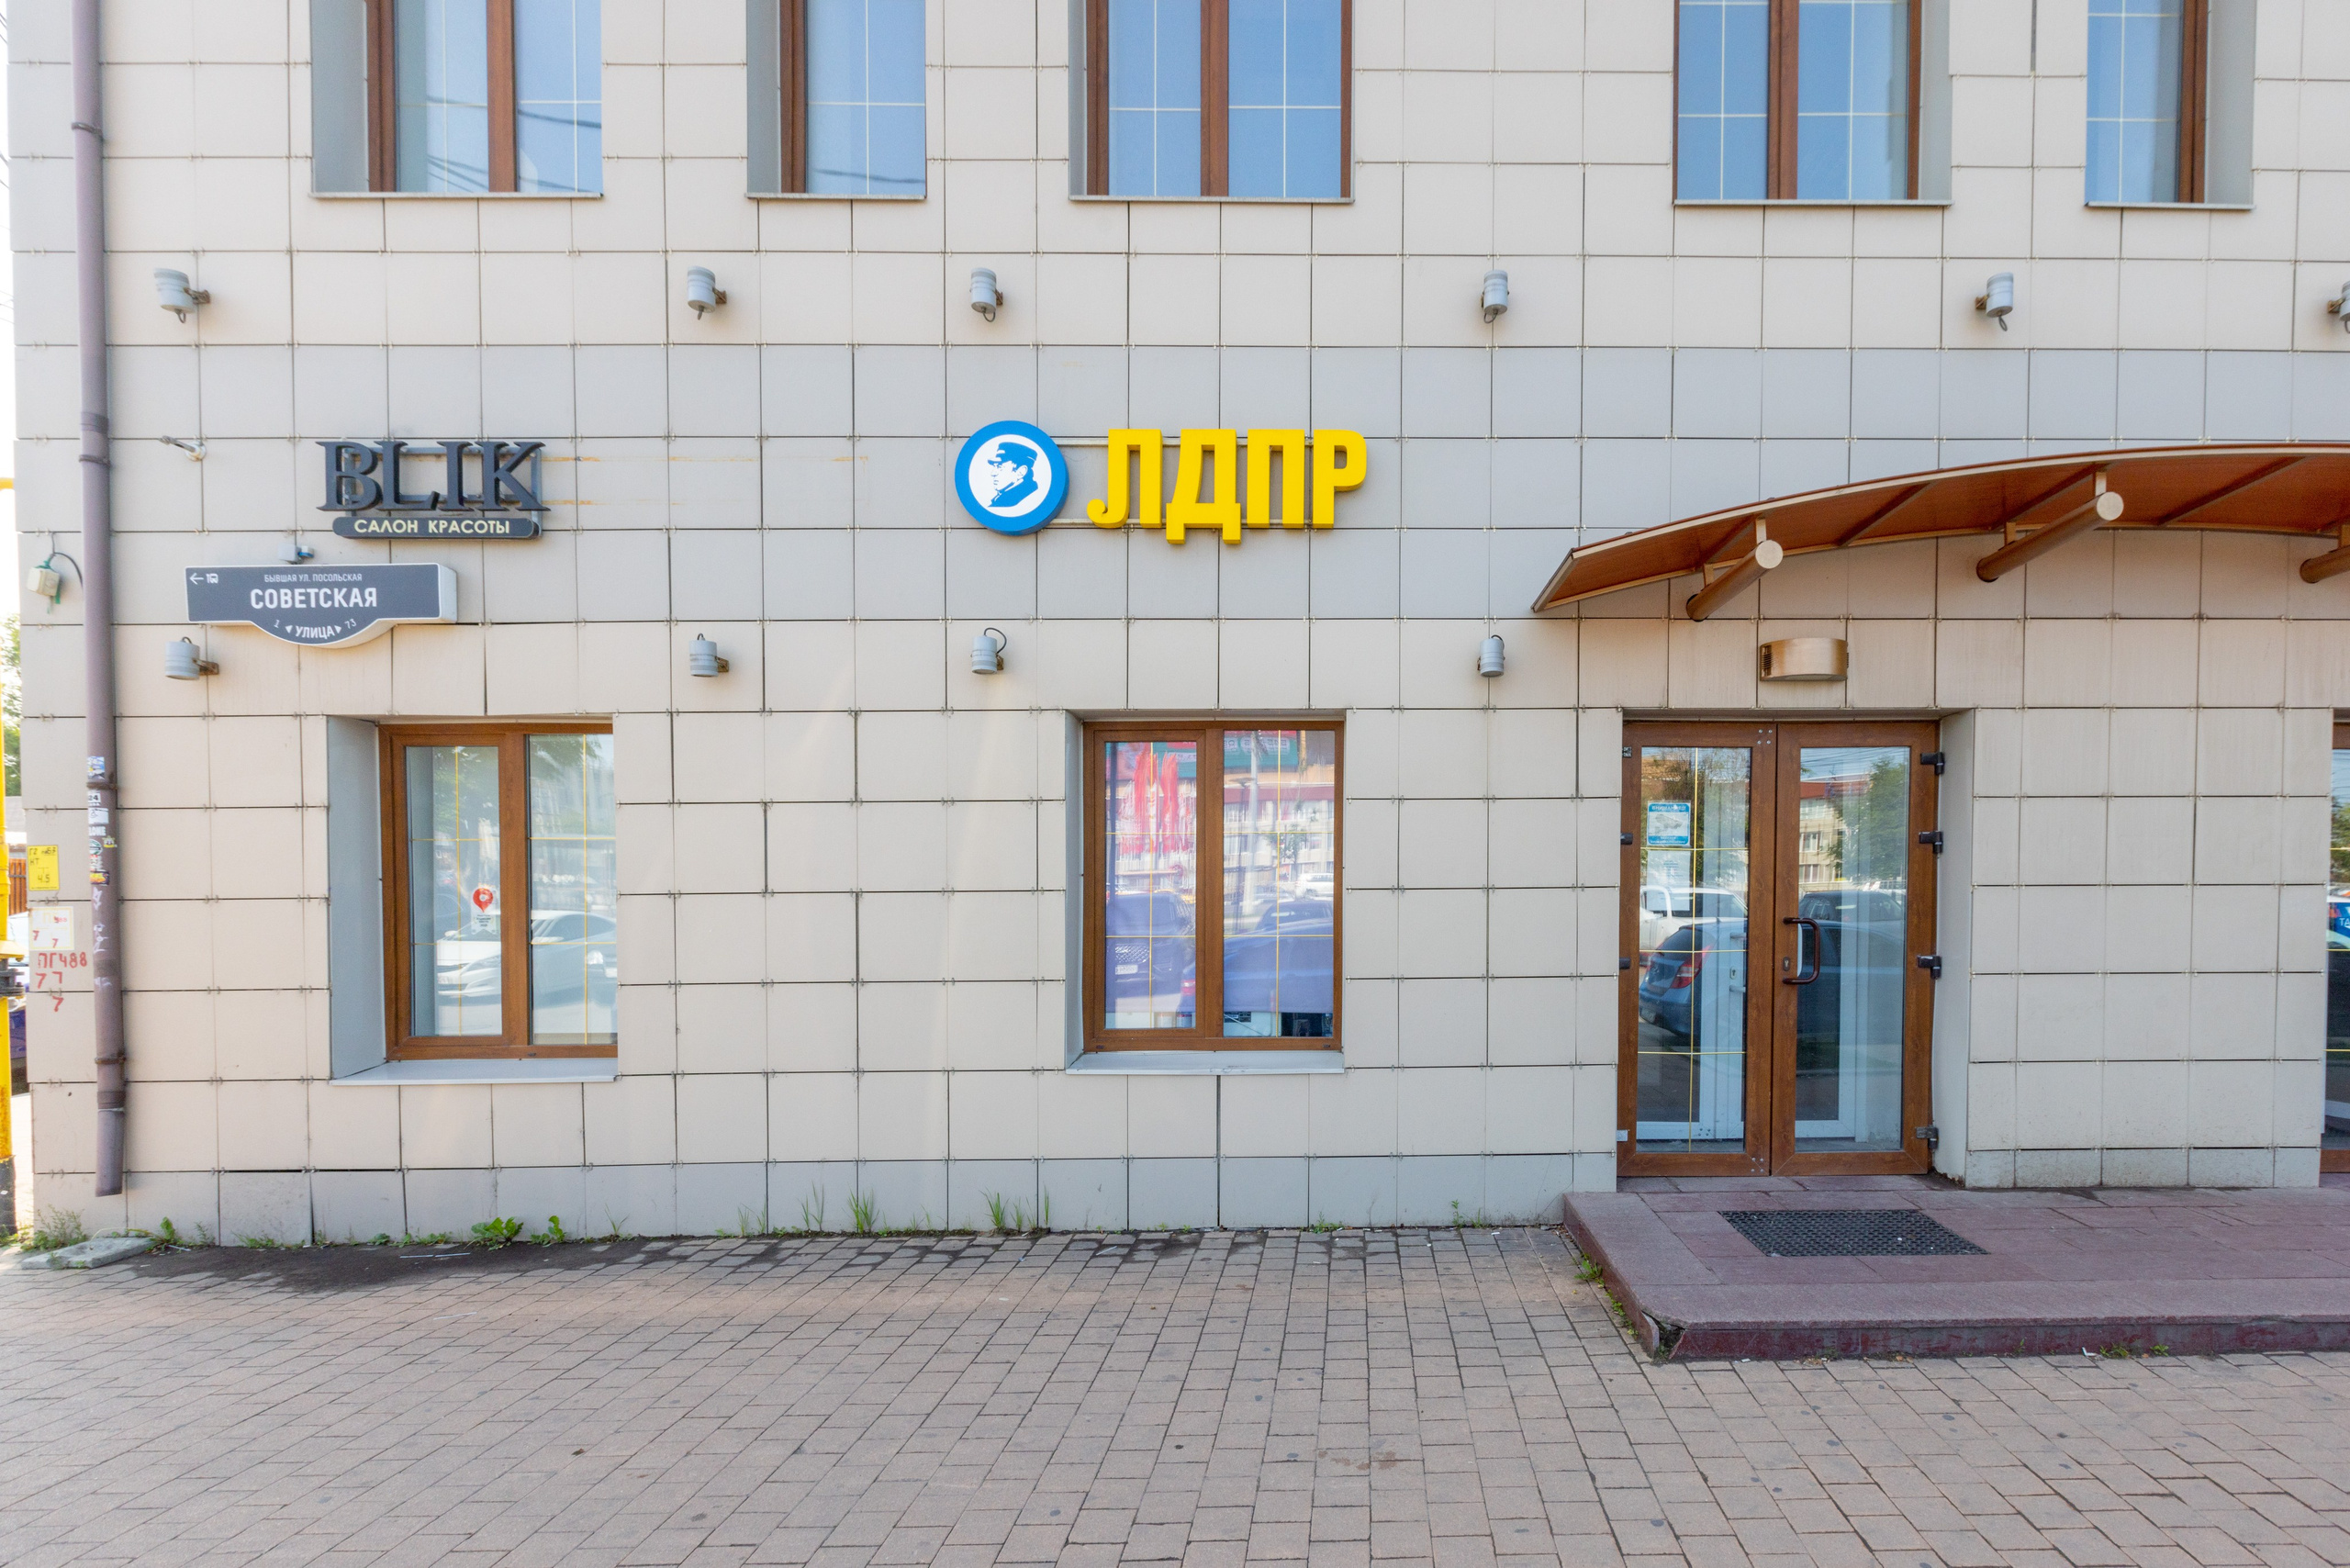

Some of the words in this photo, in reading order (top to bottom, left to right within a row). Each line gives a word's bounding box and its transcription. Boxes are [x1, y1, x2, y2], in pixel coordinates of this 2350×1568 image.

[315, 441, 551, 511] BLIK
[1087, 429, 1367, 544] ЛДПР
[353, 520, 419, 533] САЛОН
[428, 520, 509, 533] КРАСОТЫ
[263, 574, 297, 583] БЫВШАЯ
[298, 574, 311, 583] УЛ.
[312, 573, 363, 582] ПОСОЛЬСКАЯ
[250, 588, 377, 610] СОВЕТСКАЯ
[274, 619, 280, 628] 1
[295, 625, 335, 640] УЛИЦА
[344, 618, 357, 629] 73
